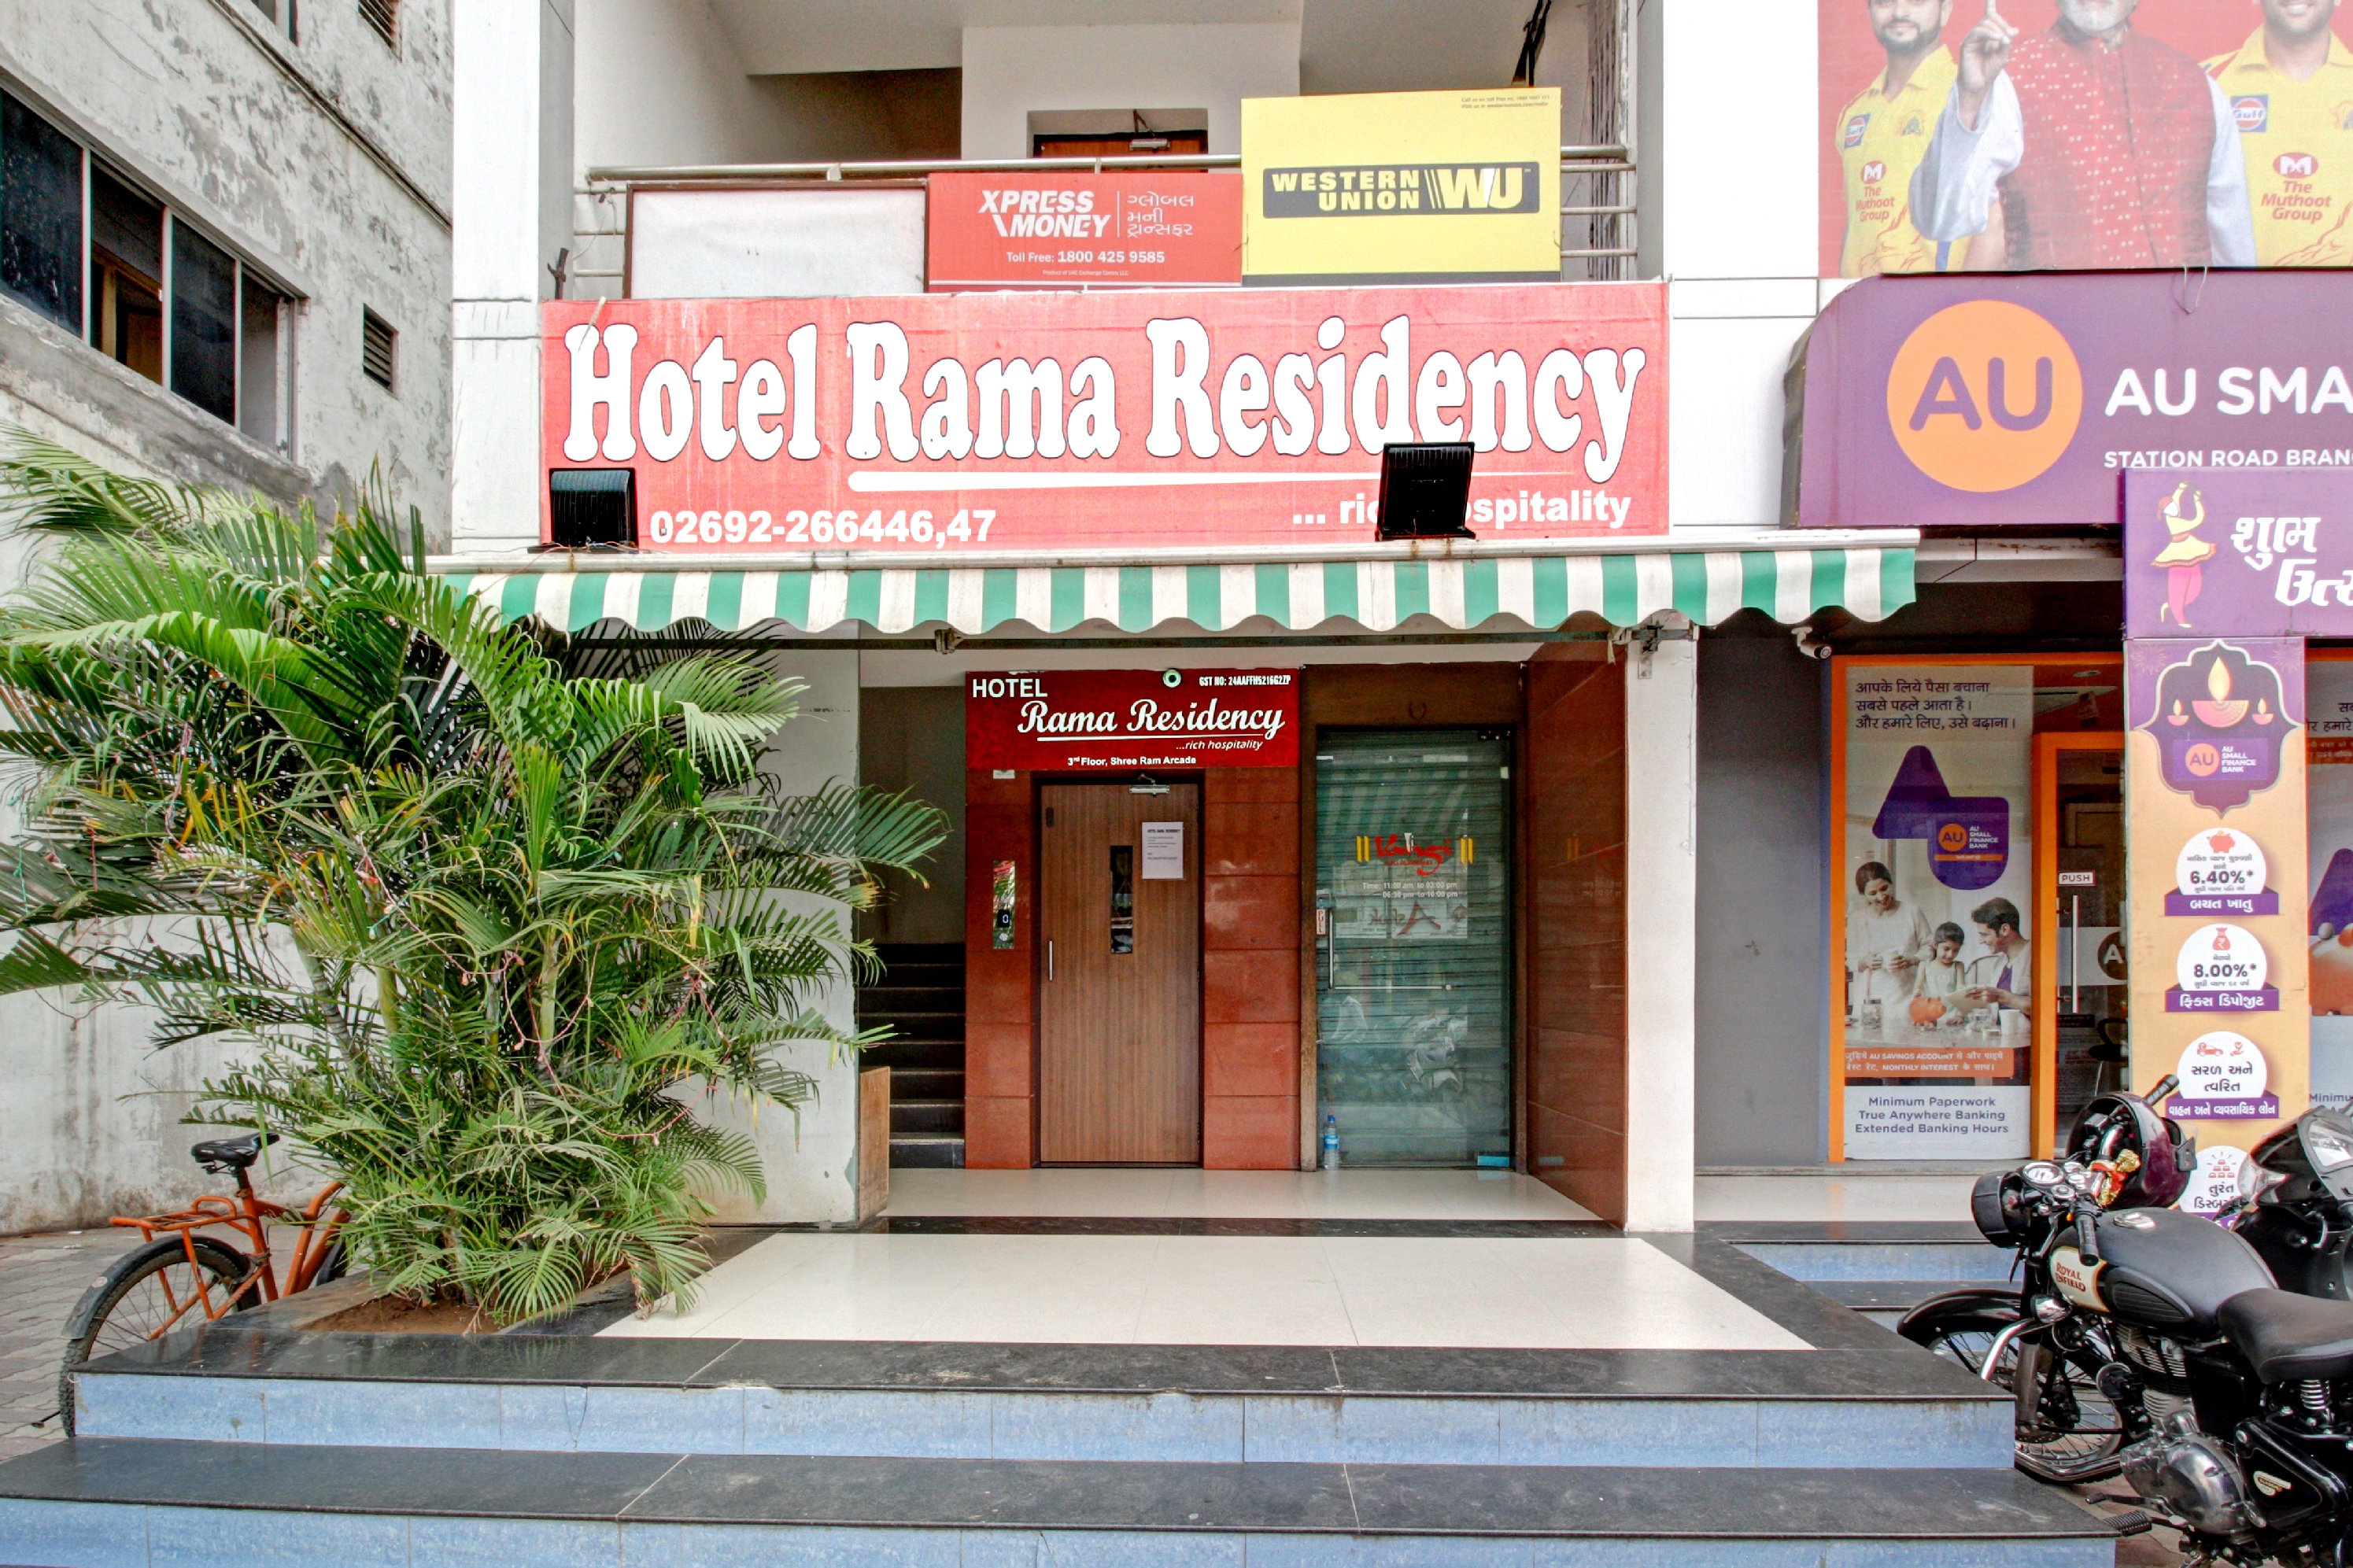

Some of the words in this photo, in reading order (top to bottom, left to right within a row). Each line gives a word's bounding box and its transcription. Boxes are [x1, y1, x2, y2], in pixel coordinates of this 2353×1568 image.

[1271, 170, 1420, 192] WESTERN
[1435, 167, 1523, 209] WU
[2283, 180, 2313, 194] The
[1126, 190, 1195, 208] ગ્લોબલ
[1864, 186, 1882, 197] The
[978, 190, 1096, 214] XPRESS
[1318, 191, 1420, 212] UNION
[1856, 196, 1895, 211] Muthoot
[2261, 193, 2332, 208] Muthoot
[1126, 208, 1164, 223] મની
[1860, 209, 1889, 223] Group
[2272, 207, 2323, 224] Group
[1004, 214, 1112, 238] MONEY
[1126, 223, 1194, 239] ટ્રાન્સફર
[1007, 252, 1025, 263] Toll
[1028, 252, 1055, 264] Free:
[1058, 251, 1094, 264] 1800
[1097, 250, 1125, 264] 425
[1128, 251, 1165, 264] 9585
[563, 323, 822, 462] Hotel
[844, 320, 1121, 462] Rama
[1145, 314, 1647, 484] Residency
[1908, 356, 2053, 432] AU
[2104, 367, 2196, 417] AU
[2216, 366, 2353, 416] SMA
[2104, 449, 2203, 469] STATION
[2211, 449, 2279, 467] ROAD
[2286, 448, 2353, 466] BRAN
[1339, 493, 1379, 524] ri
[1465, 489, 1631, 529] spitality
[649, 508, 997, 549] 02692-266446,47
[2229, 517, 2322, 571] शुभ
[972, 678, 1048, 698] HOTEL
[1199, 677, 1213, 687] GST
[1214, 676, 1227, 686] NO:
[1855, 678, 1893, 693] आपके
[1896, 678, 1923, 693] लिये
[1925, 678, 1949, 692] पैसा
[1953, 682, 1990, 692] बचाना
[1855, 696, 1887, 711] सबसे
[1890, 695, 1920, 711] पहले
[1923, 700, 1952, 711] आता
[1017, 699, 1117, 733] Rama
[1126, 698, 1285, 740] Residency
[1856, 714, 1879, 729] और
[1882, 714, 1914, 729] हमारे
[1915, 714, 1945, 730] लिए,
[1948, 714, 1969, 729] उसे
[2322, 717, 2353, 732] हमारे
[1176, 740, 1206, 751] ...rich
[1207, 739, 1263, 751] hospitality
[1067, 756, 1080, 767] 3rd
[1080, 757, 1108, 767] Floor,
[1110, 756, 1138, 766] Shree
[1139, 756, 1162, 766] Ram
[1162, 755, 1197, 766] Arcade
[2189, 753, 2214, 766] AU
[1941, 832, 1963, 843] AU
[2061, 873, 2090, 883] PUSH
[2189, 899, 2222, 909] બચત
[2191, 1065, 2222, 1075] સરળ
[2228, 1061, 2253, 1075] અને
[2203, 1079, 2240, 1093] ત્વરિત
[1869, 1097, 1925, 1107] Minimum
[1929, 1097, 1997, 1109] Paperwork
[2309, 1093, 2353, 1102] Minimu
[2168, 1105, 2192, 1116] વાહન
[2193, 1101, 2211, 1116] અને
[2258, 1101, 2275, 1115] લોન
[1859, 1110, 1886, 1120] True
[1889, 1110, 1952, 1123] Anywhere
[1955, 1110, 2006, 1123] Banking
[1855, 1123, 1914, 1134] Extended
[1918, 1123, 1968, 1135] Banking
[1973, 1123, 2009, 1134] Hours
[2209, 1181, 2234, 1197] તુરંત
[2056, 1262, 2082, 1281] ROYAL
[2055, 1272, 2086, 1293] ENFIELD
